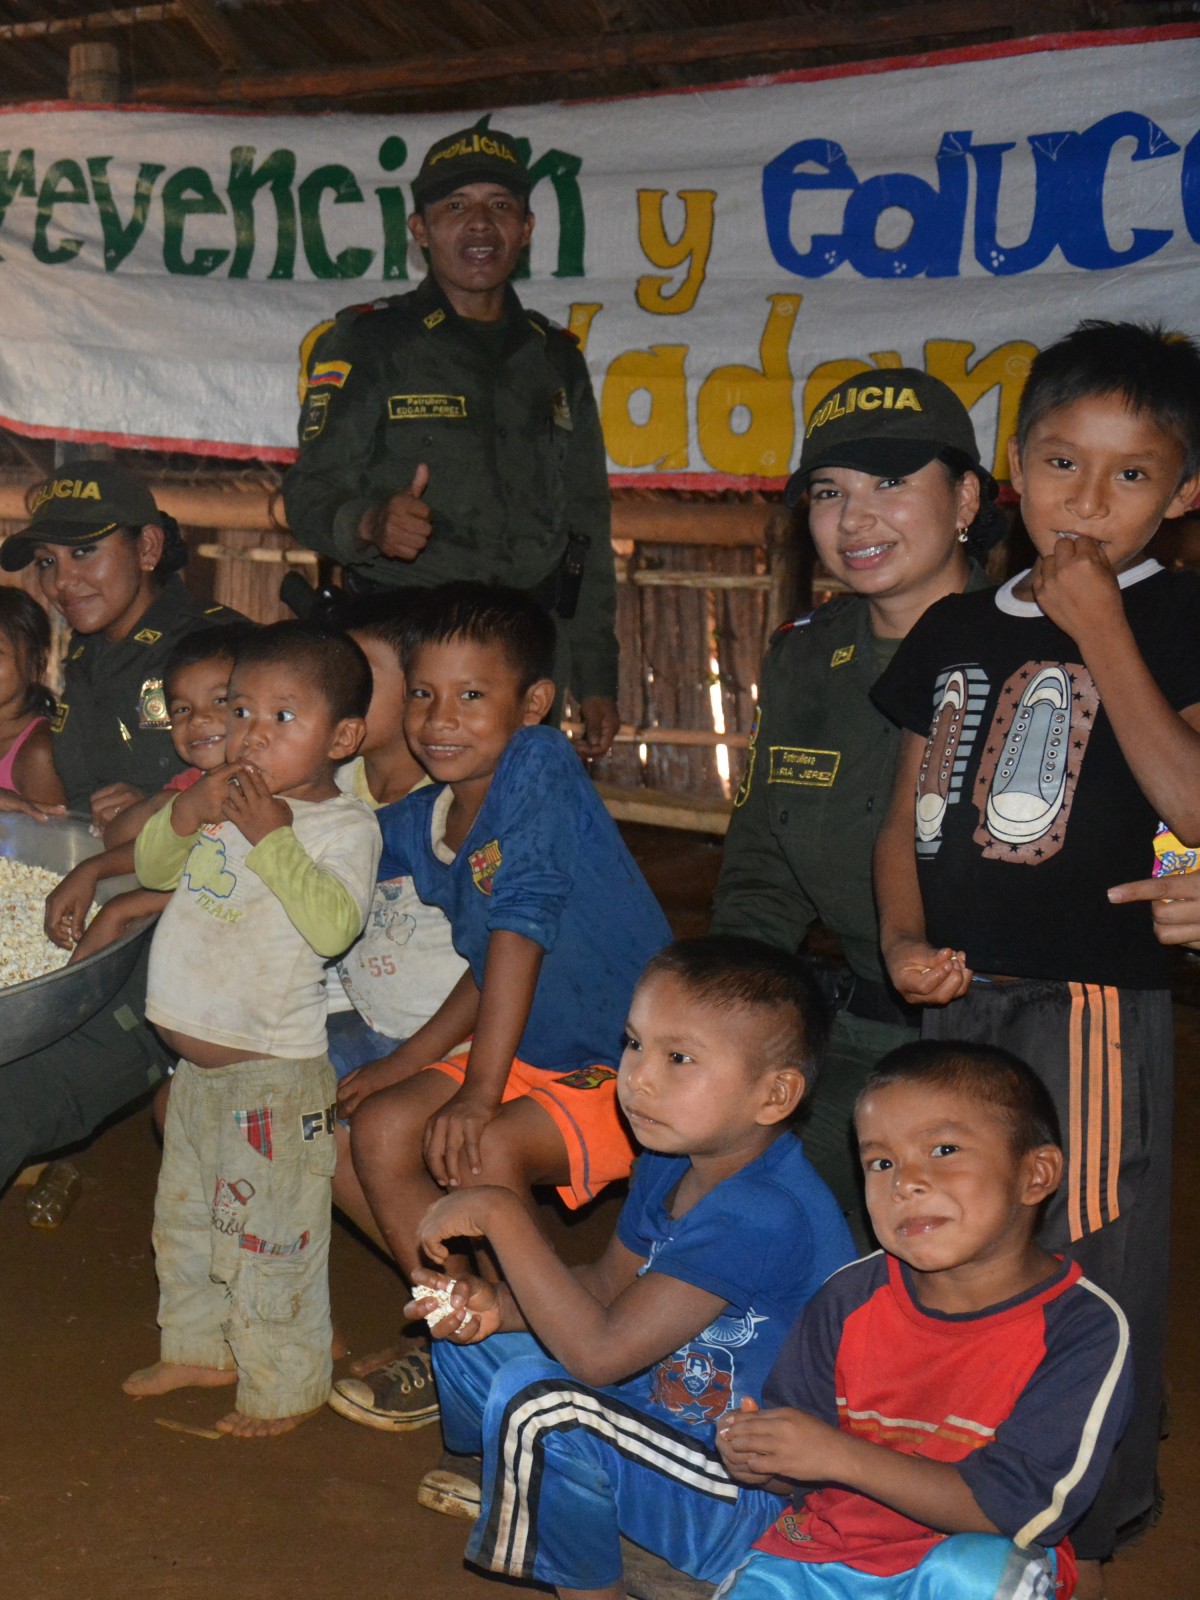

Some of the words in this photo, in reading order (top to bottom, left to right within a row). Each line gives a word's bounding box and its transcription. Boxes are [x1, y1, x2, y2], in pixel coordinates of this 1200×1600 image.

[636, 188, 717, 313] y
[805, 386, 923, 438] POLICIA
[799, 769, 832, 781] JEREZ
[194, 891, 243, 923] TEAM
[367, 953, 397, 978] 55
